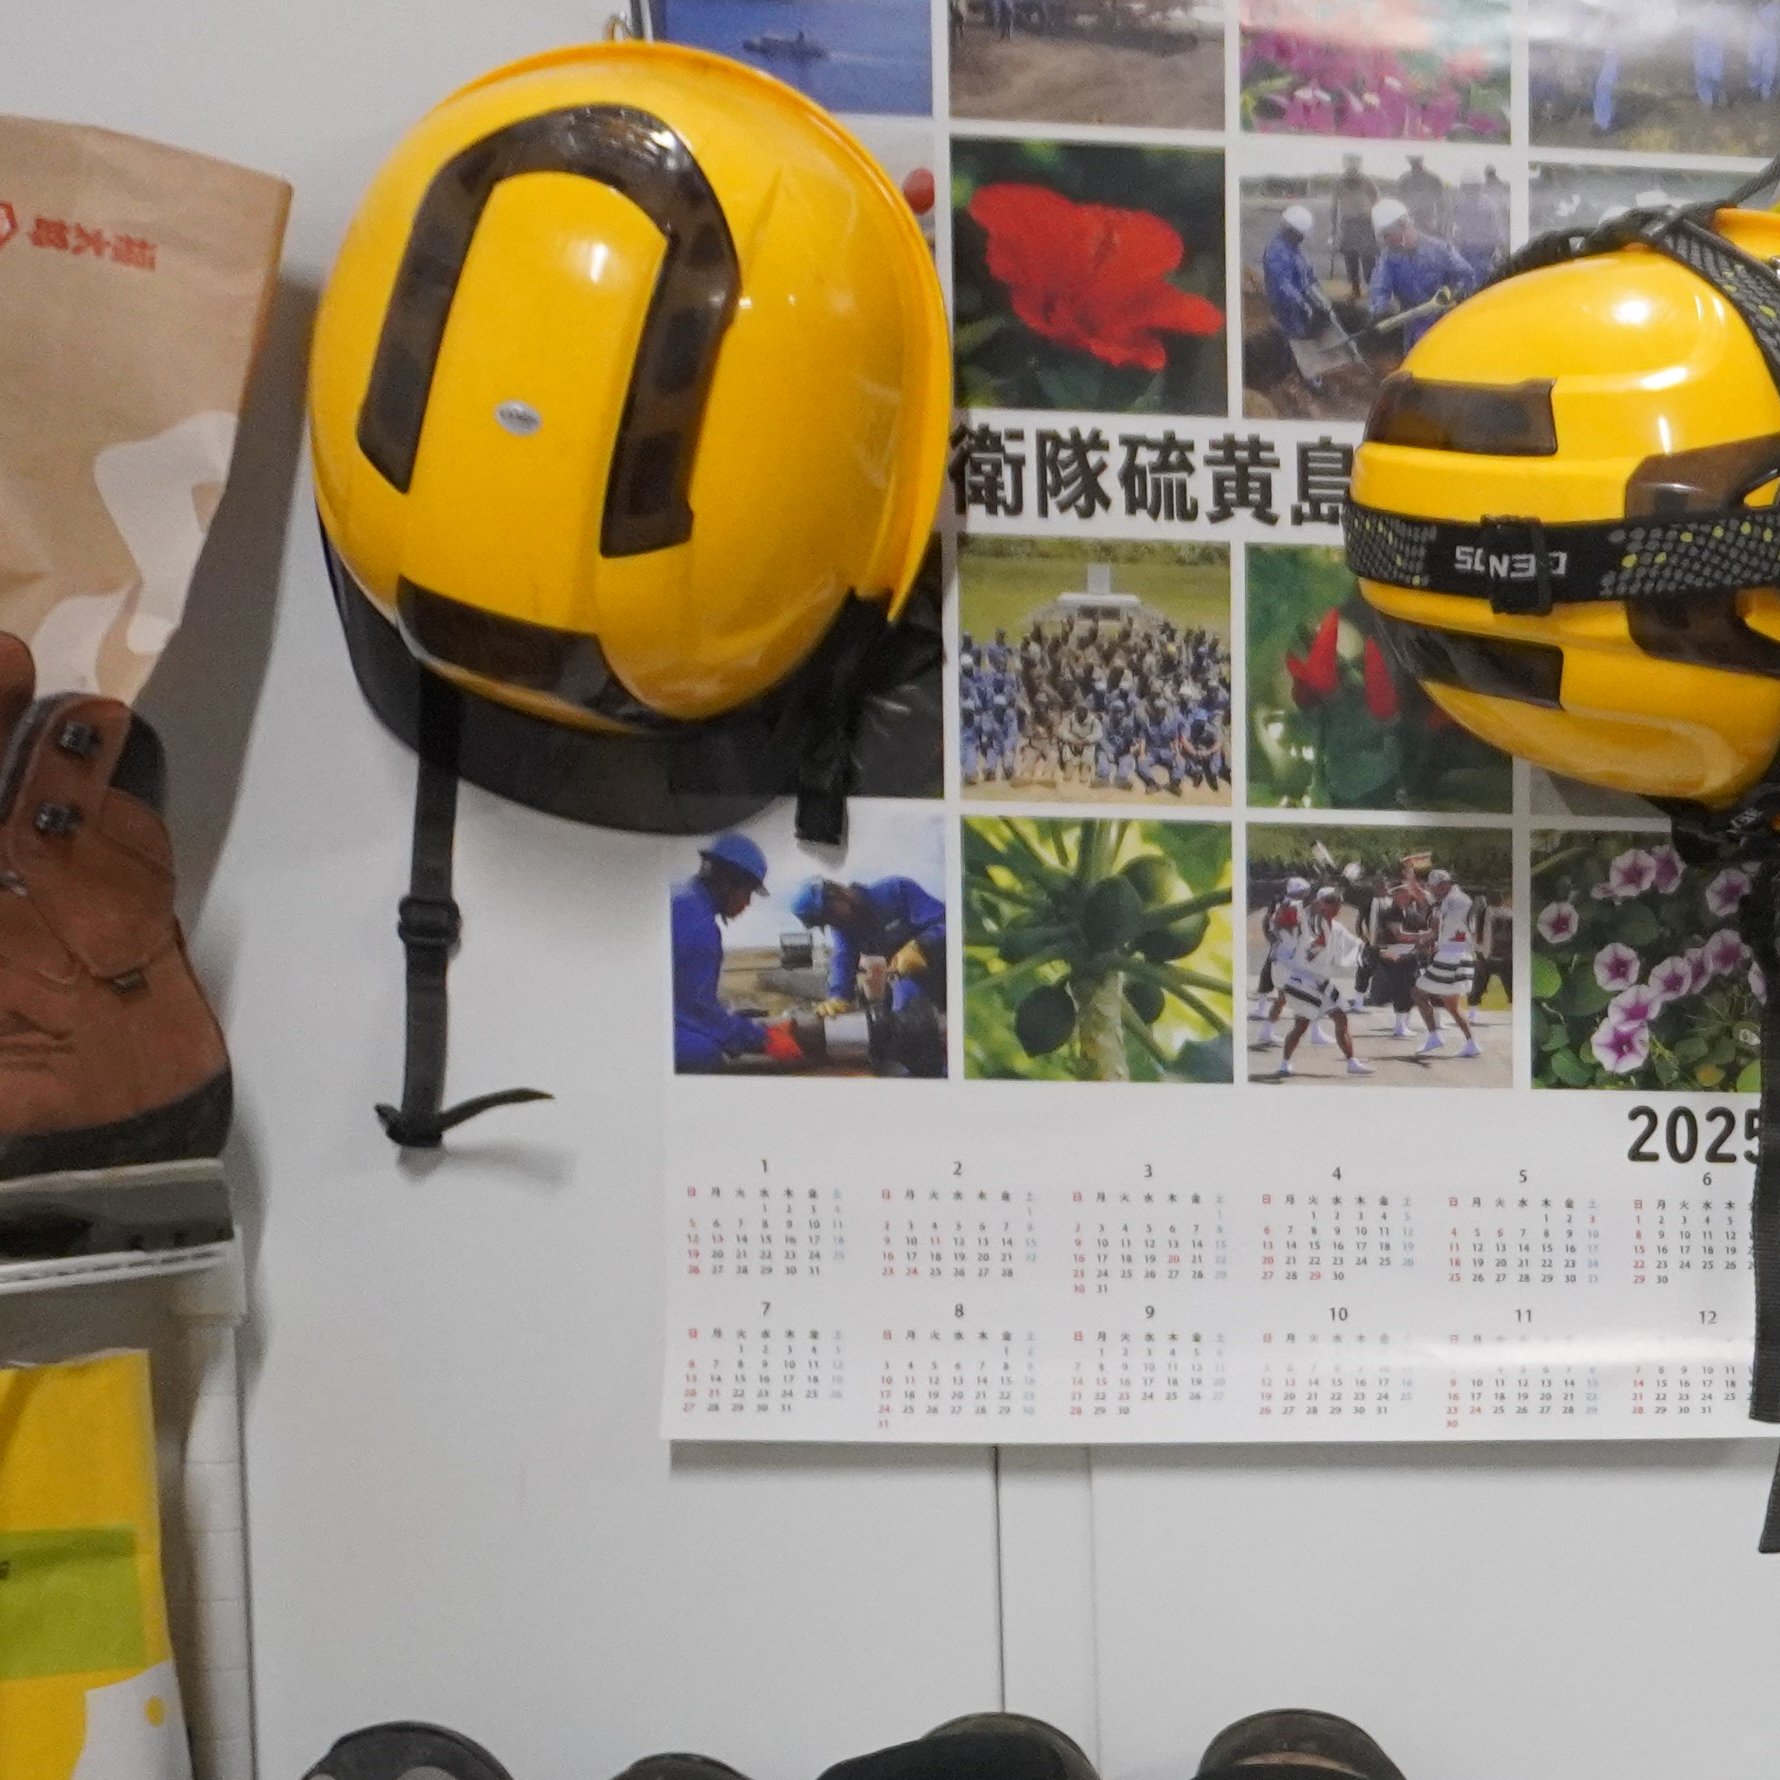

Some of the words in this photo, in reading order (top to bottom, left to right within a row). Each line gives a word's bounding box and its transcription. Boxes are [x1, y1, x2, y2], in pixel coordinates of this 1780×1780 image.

[761, 1158, 768, 1174] 1
[952, 1160, 963, 1177] 2
[1144, 1163, 1153, 1179] 3
[1332, 1166, 1342, 1181] 4
[1518, 1168, 1528, 1184] 5
[1702, 1171, 1713, 1187] 6
[761, 1301, 772, 1316] 7
[954, 1303, 965, 1319] 8
[1144, 1305, 1156, 1320] 9
[1329, 1306, 1349, 1322] 10
[1515, 1308, 1532, 1323] 11
[1699, 1310, 1718, 1325] 12
